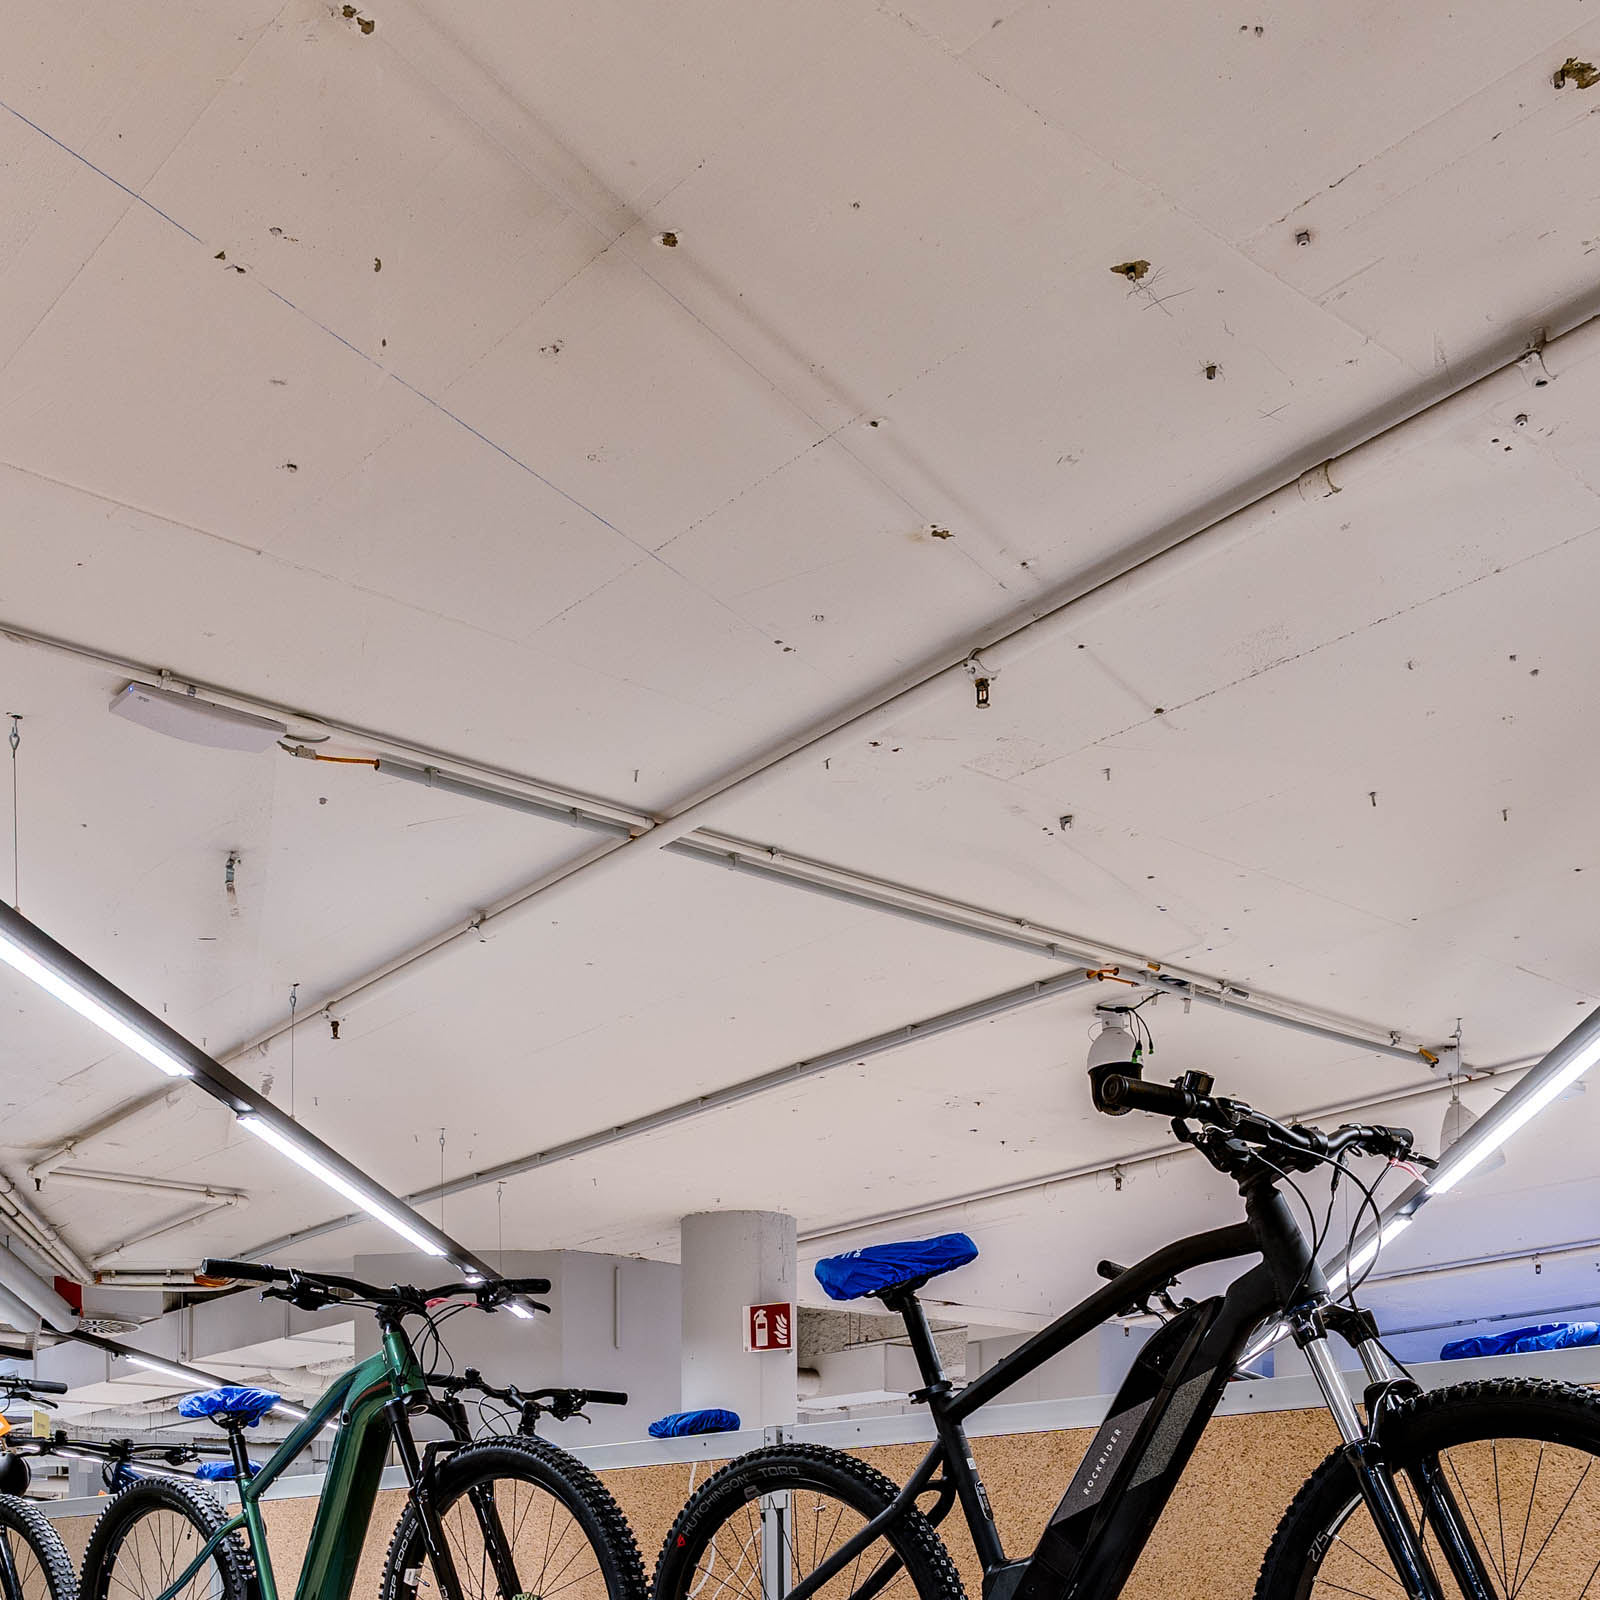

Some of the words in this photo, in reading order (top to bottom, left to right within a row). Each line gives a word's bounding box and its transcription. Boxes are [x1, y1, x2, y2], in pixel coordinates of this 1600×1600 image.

[1083, 1428, 1122, 1495] ROCKRIDER
[682, 1474, 746, 1537] HUTCHINSON
[757, 1465, 800, 1478] TORO
[394, 1539, 409, 1573] 500
